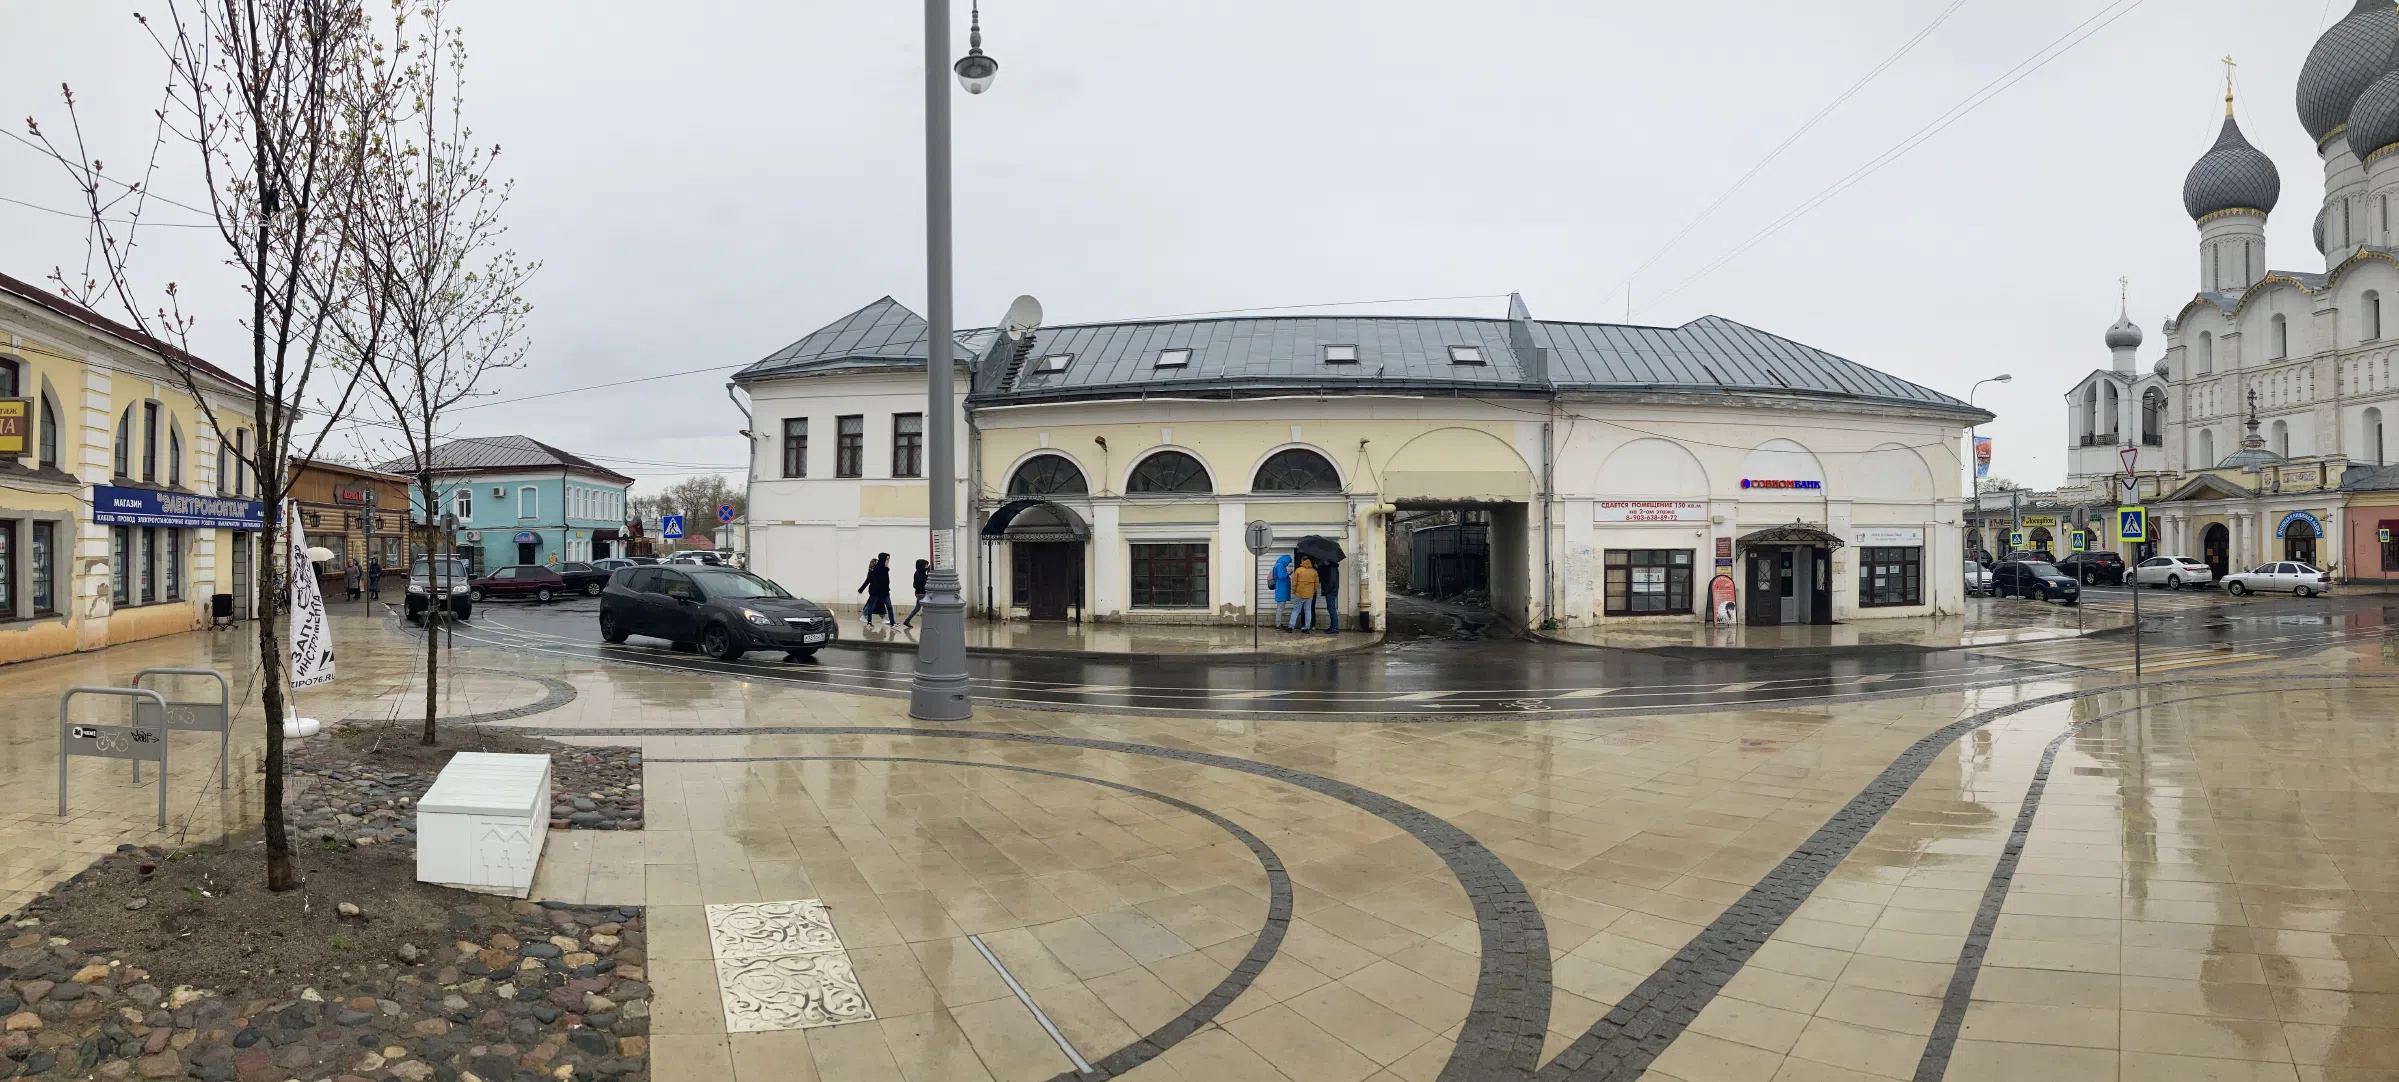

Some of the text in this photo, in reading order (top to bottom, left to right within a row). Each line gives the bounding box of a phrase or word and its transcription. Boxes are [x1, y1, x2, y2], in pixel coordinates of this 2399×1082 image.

[1751, 480, 1821, 489] СОВКОМБАНК
[113, 498, 142, 509] МАГАЗИН
[97, 514, 115, 522] КАБЕЛЬ
[117, 515, 136, 524] ПРОВОД
[297, 595, 321, 676] ИНСТРУМЕНТА
